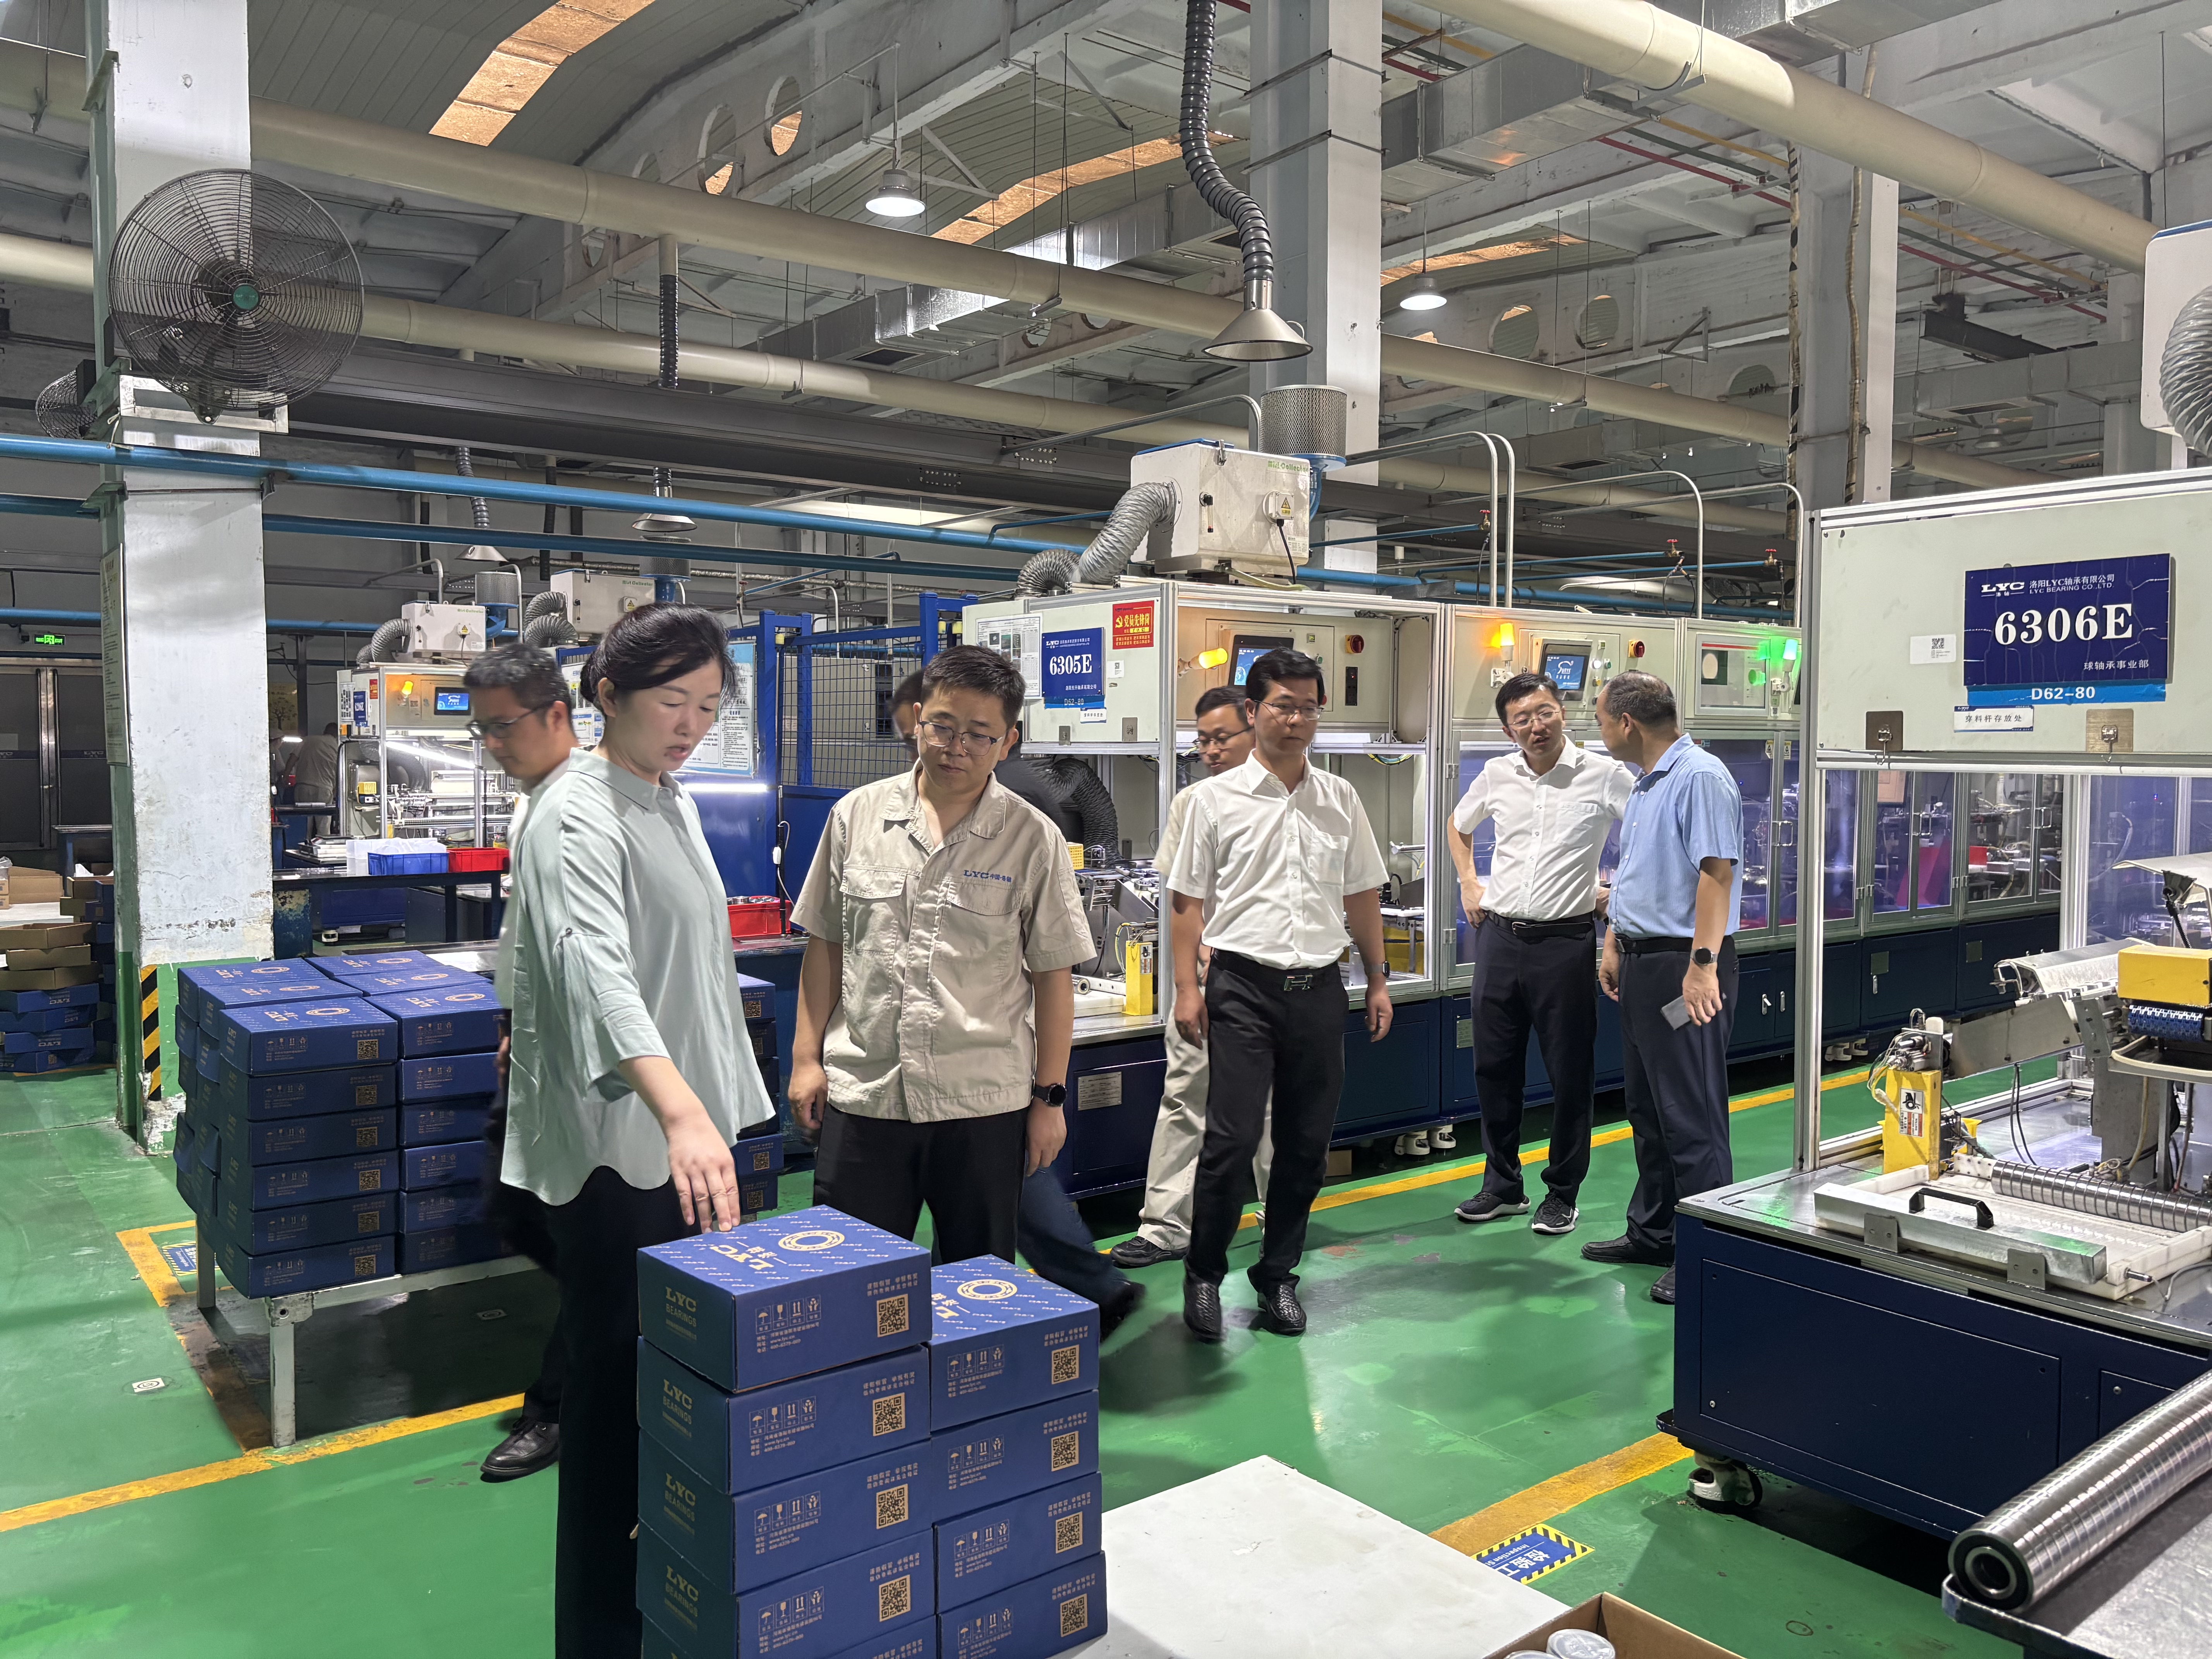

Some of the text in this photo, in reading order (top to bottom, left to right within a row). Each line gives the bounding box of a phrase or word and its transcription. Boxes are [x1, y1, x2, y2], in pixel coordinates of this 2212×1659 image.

[1981, 582, 2025, 593] LYC
[2029, 574, 2114, 589] 洛阳LYC轴承有限公司
[2046, 584, 2080, 593] BEARING
[1994, 603, 2132, 645] 6306E
[1049, 654, 1092, 675] 6305E
[2083, 659, 2149, 671] 球轴承事业部
[2031, 687, 2095, 700] D62-80
[964, 870, 989, 879] LYC
[710, 1244, 775, 1271] LYC
[666, 1286, 696, 1312] LYC
[666, 1303, 697, 1327] BEARINGS
[663, 1379, 693, 1410] LYC
[663, 1395, 692, 1425] BEARINGS
[666, 1473, 696, 1506] LYC
[1492, 1544, 1530, 1562] Inspection
[666, 1565, 699, 1602] LYC
